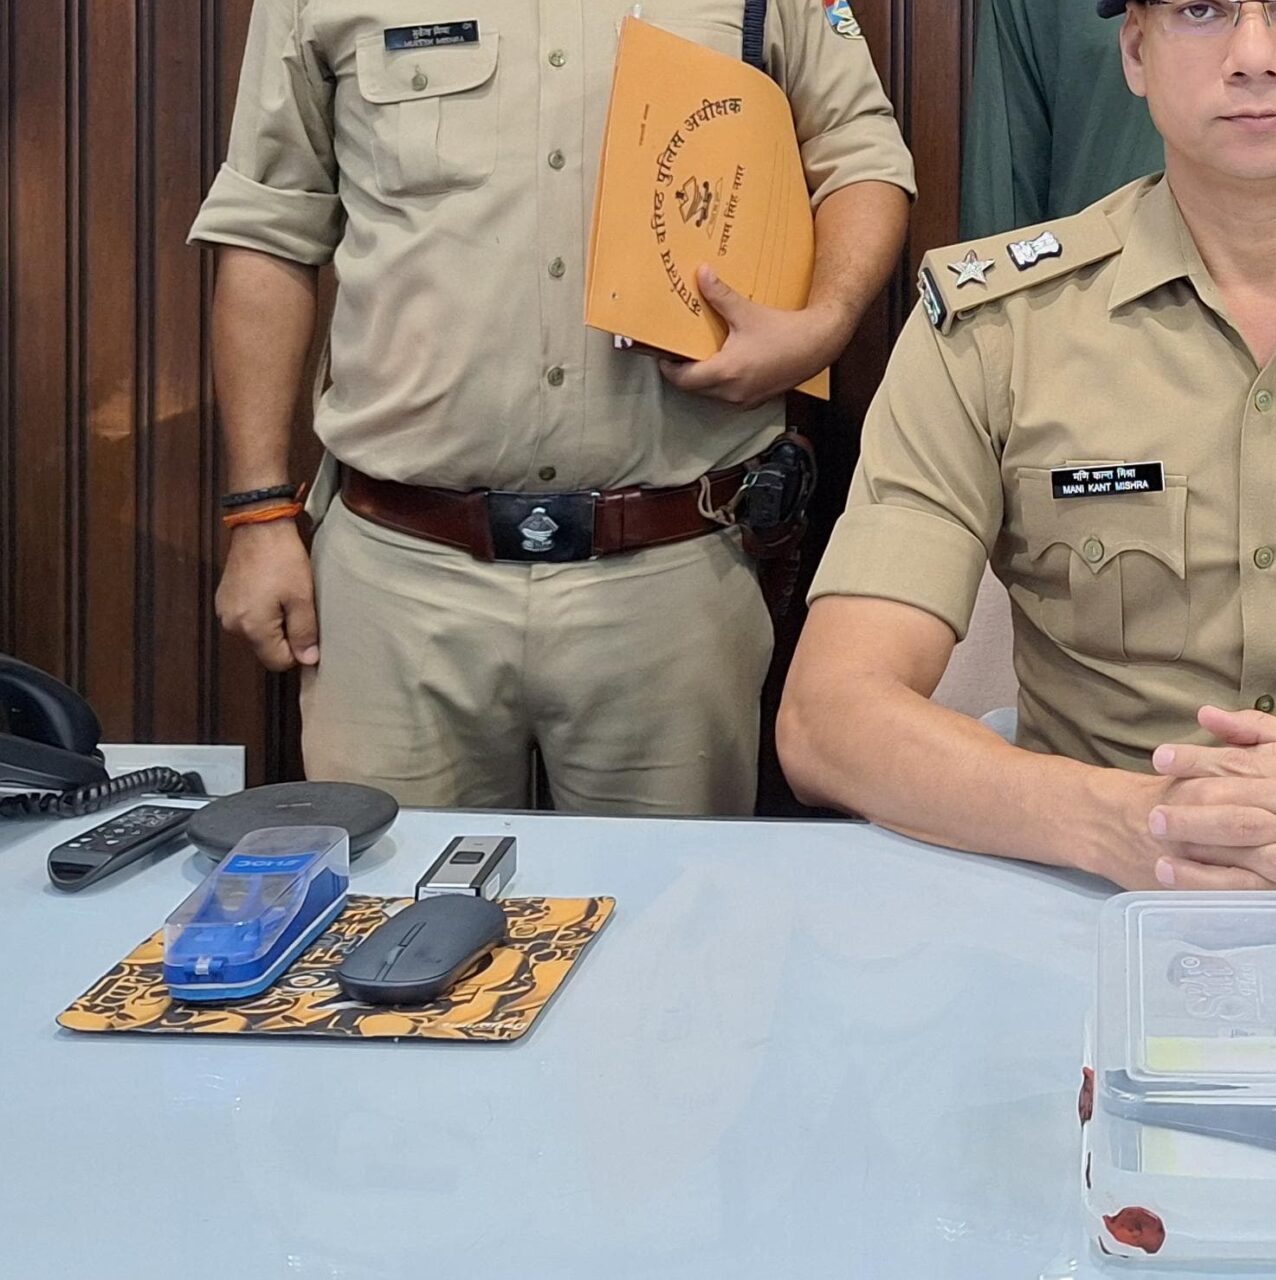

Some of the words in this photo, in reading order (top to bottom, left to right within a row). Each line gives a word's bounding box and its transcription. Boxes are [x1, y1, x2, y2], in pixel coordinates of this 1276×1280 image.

[684, 98, 742, 132] अधीक्षक
[656, 129, 685, 187] पुलिस
[651, 188, 666, 245] वरिष्ठ
[724, 194, 738, 219] सिंह
[732, 164, 746, 190] नगर
[661, 248, 702, 317] कार्यालय
[1062, 484, 1085, 494] MANI
[1088, 482, 1112, 493] KANT
[1115, 480, 1149, 491] MISHRA
[1117, 467, 1136, 479] मिश्रा
